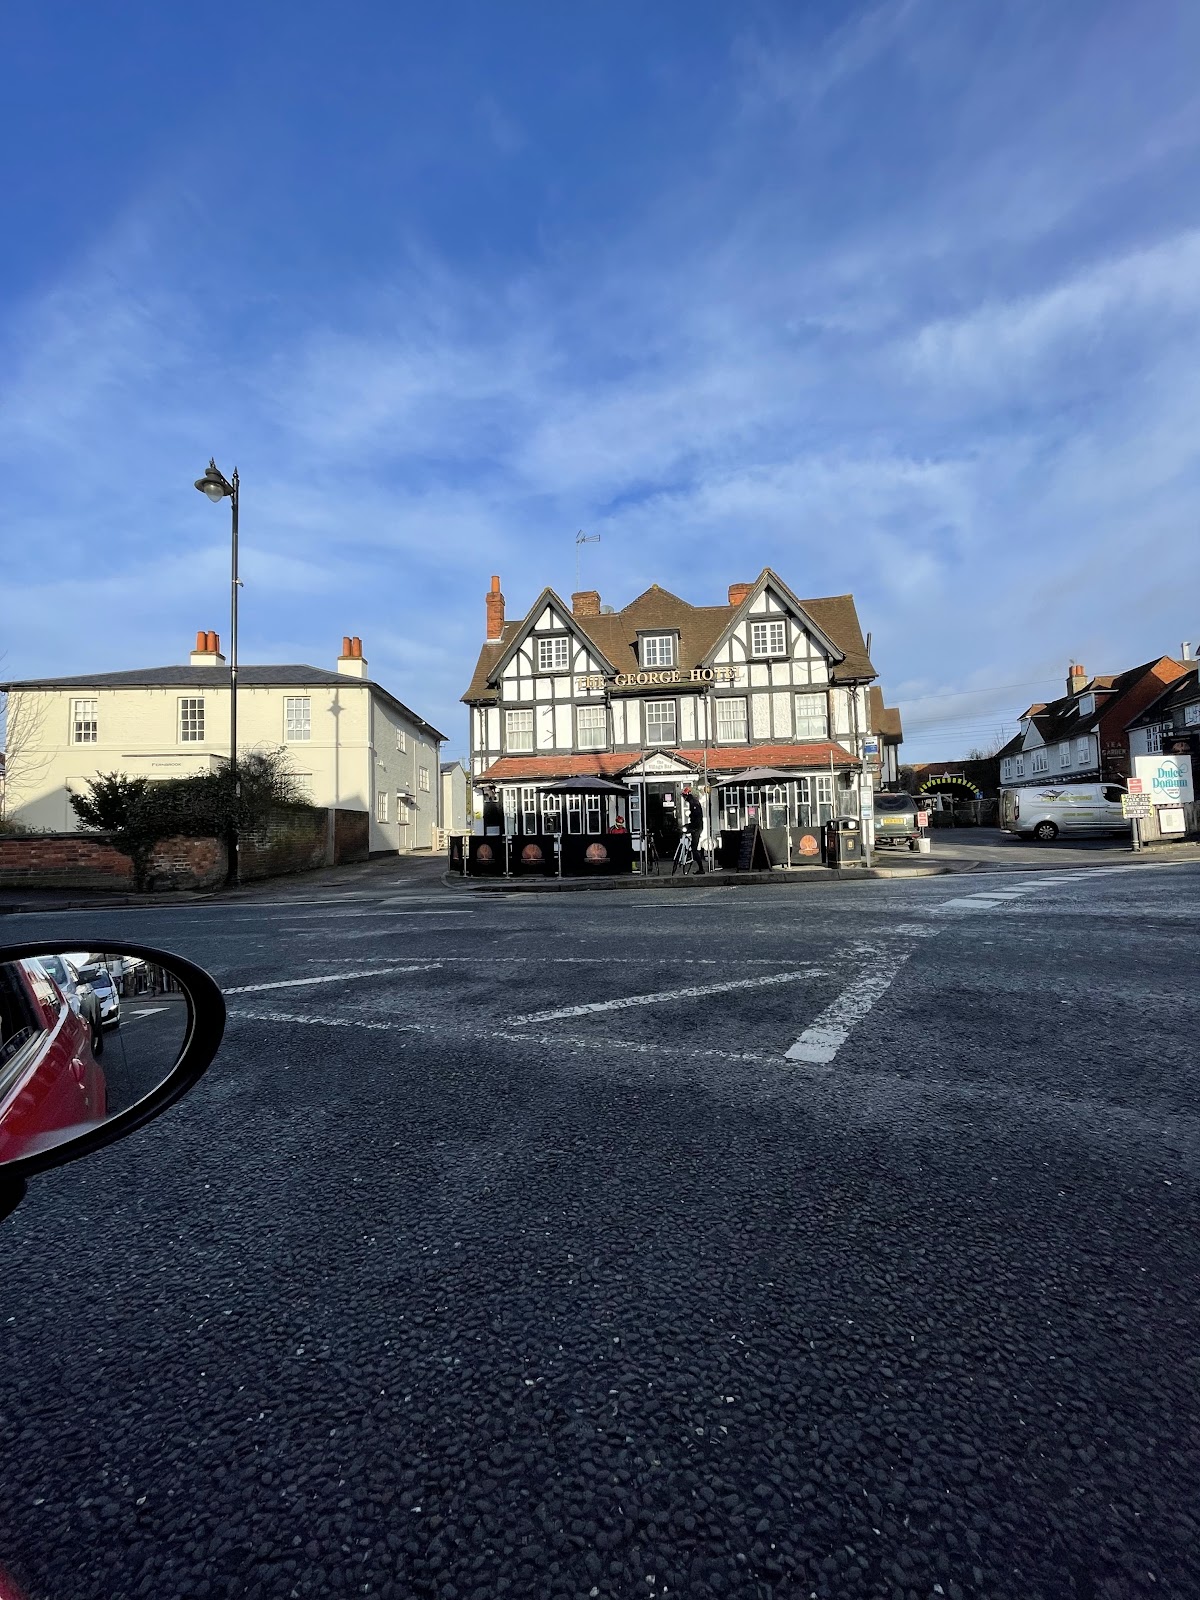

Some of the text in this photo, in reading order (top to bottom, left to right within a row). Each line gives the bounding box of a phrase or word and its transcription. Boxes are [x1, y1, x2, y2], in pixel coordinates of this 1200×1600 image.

[577, 667, 745, 689] THE GEORGE HOTEL
[1157, 768, 1183, 778] Dulce
[1152, 778, 1188, 788] Domum
